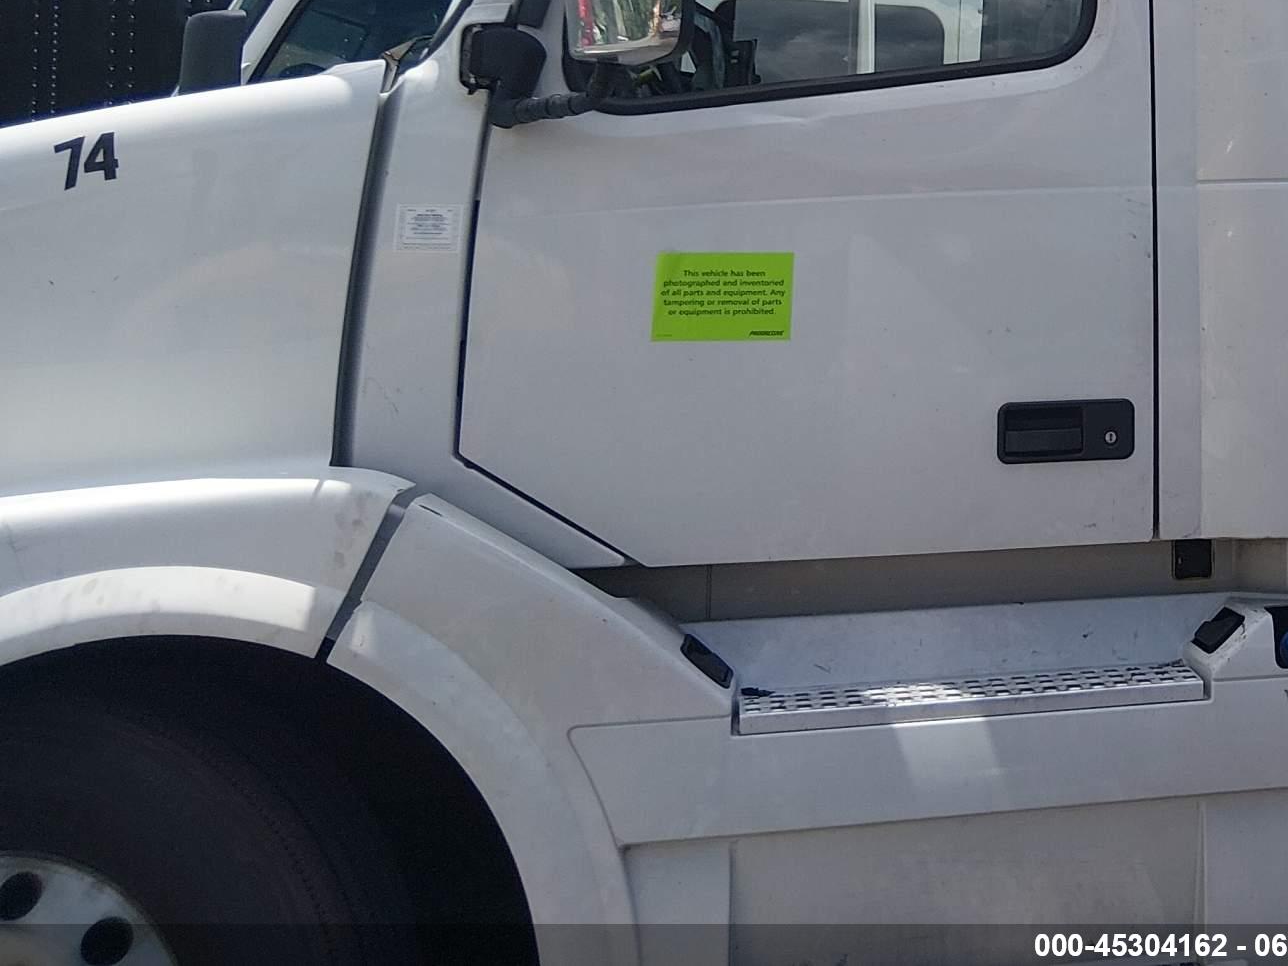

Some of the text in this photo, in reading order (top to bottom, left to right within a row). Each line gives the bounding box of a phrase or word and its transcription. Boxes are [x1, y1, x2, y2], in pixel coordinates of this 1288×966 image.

[54, 132, 119, 191] 74
[683, 269, 766, 277] This vehicle has been
[663, 279, 784, 288] photographed and inventoried
[660, 289, 785, 298] of all parts and equipment. Any
[663, 299, 705, 307] tampering
[717, 298, 750, 307] removal
[751, 298, 760, 306] of
[762, 299, 782, 307] parts
[679, 309, 722, 317] equipment
